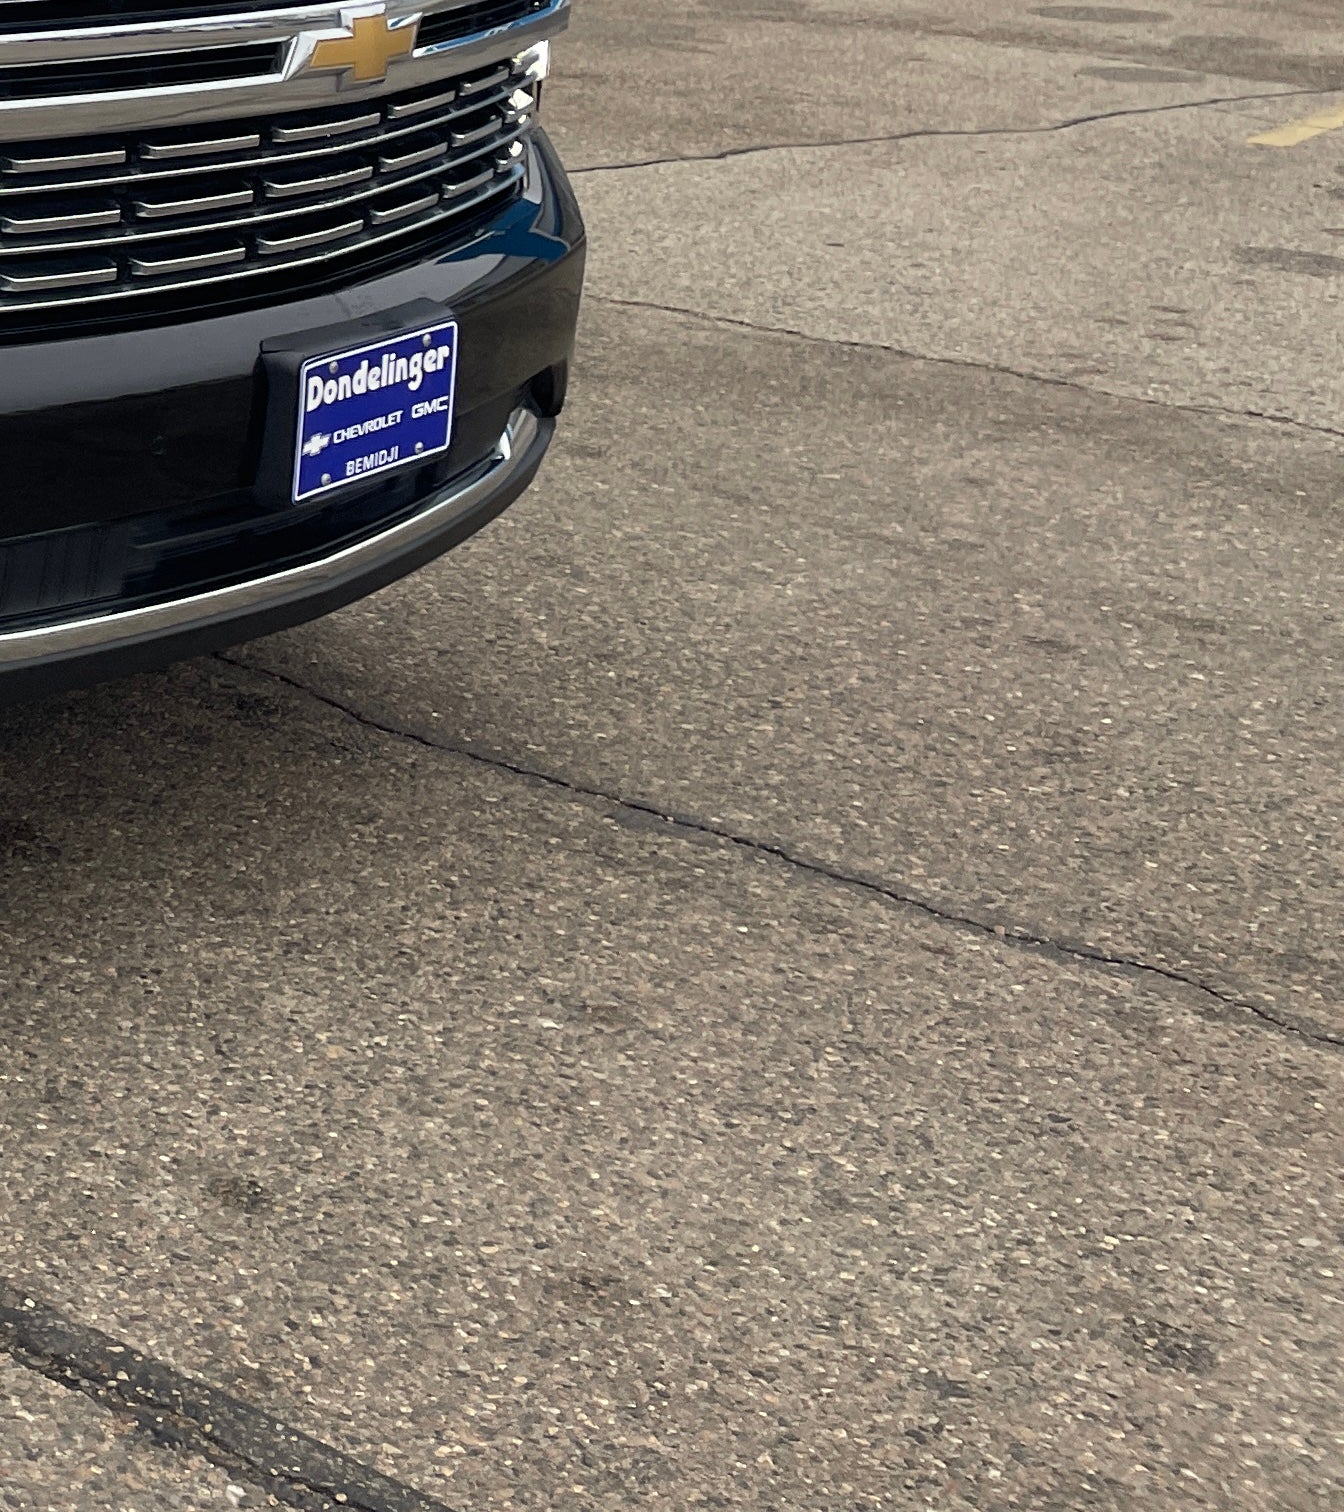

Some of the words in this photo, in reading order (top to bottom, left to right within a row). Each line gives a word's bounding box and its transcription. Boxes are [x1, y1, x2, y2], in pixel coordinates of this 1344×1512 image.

[306, 344, 450, 412] Dondelinger
[333, 410, 403, 444] CHEVROLET
[411, 395, 449, 419] GMC
[345, 445, 399, 476] BEMIDJI
